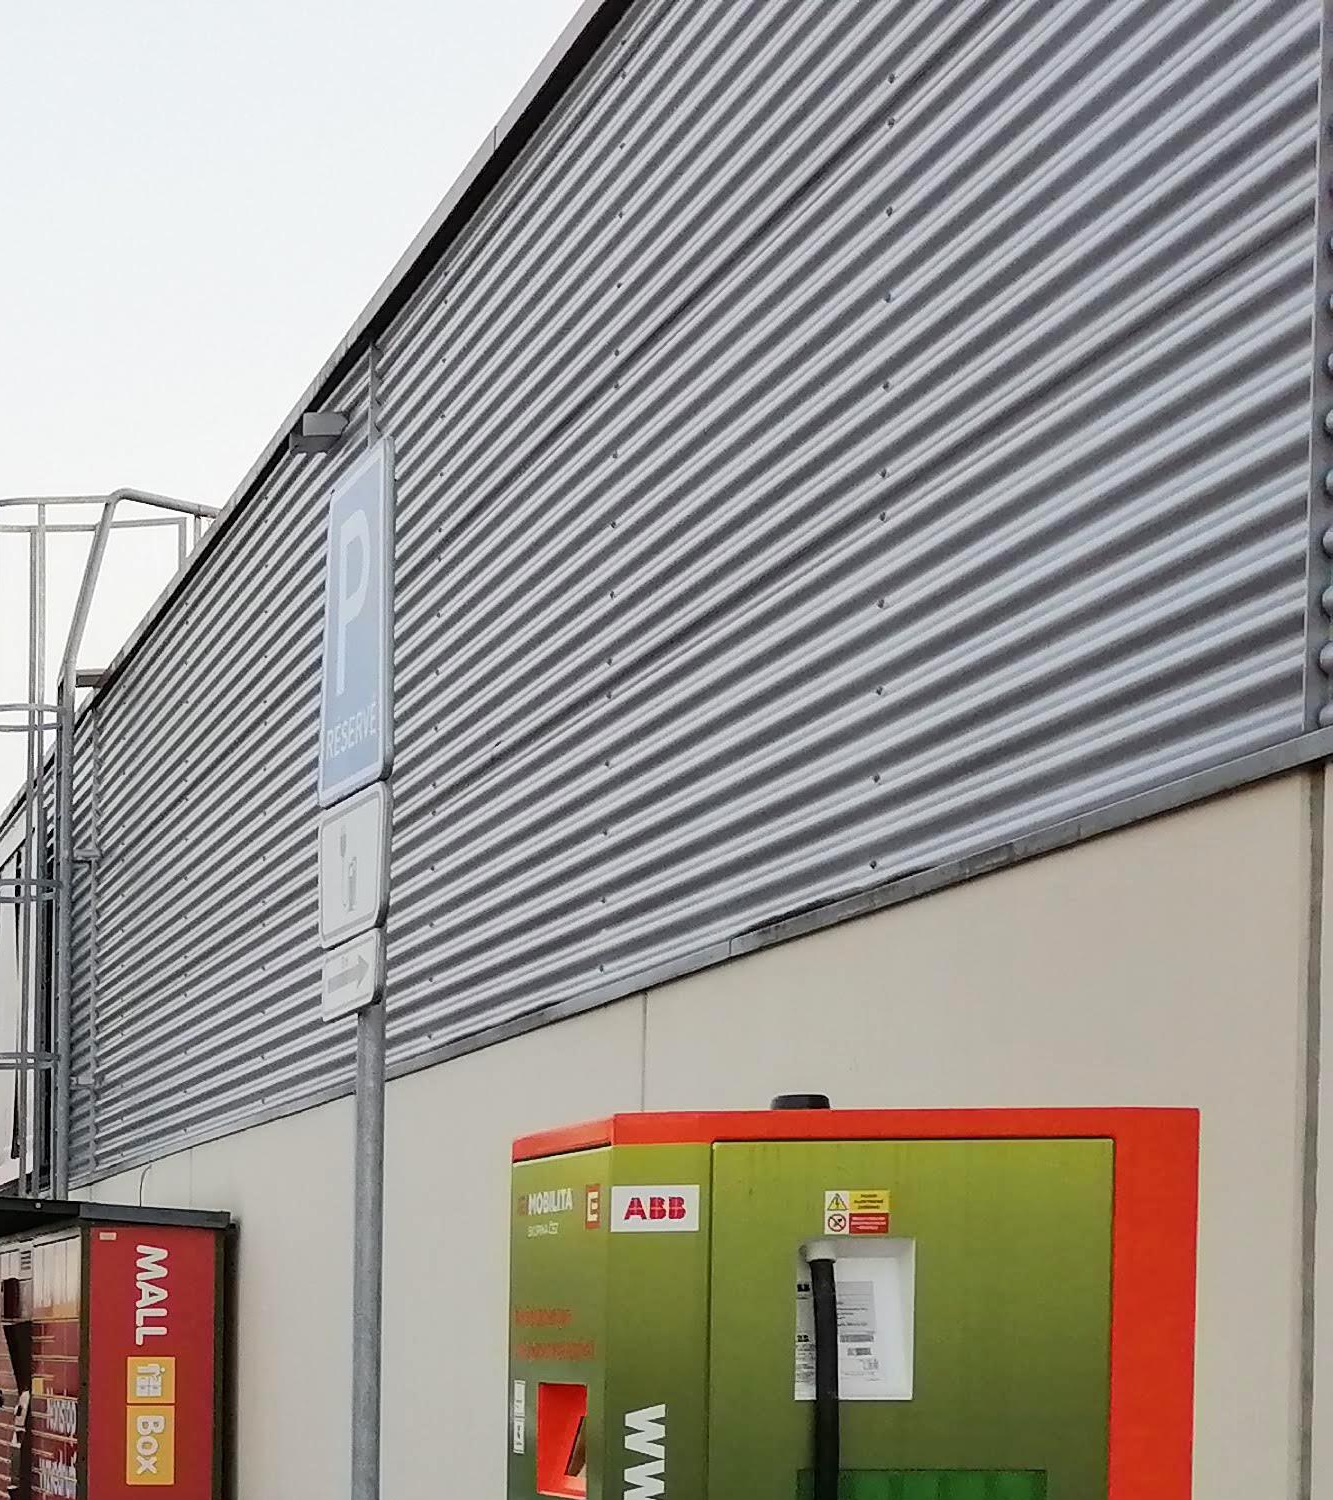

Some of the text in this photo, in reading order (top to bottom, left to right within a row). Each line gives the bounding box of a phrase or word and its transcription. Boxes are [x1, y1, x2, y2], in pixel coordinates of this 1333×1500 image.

[337, 509, 370, 696] P
[624, 1197, 686, 1220] ABB
[135, 1244, 168, 1346] MALL
